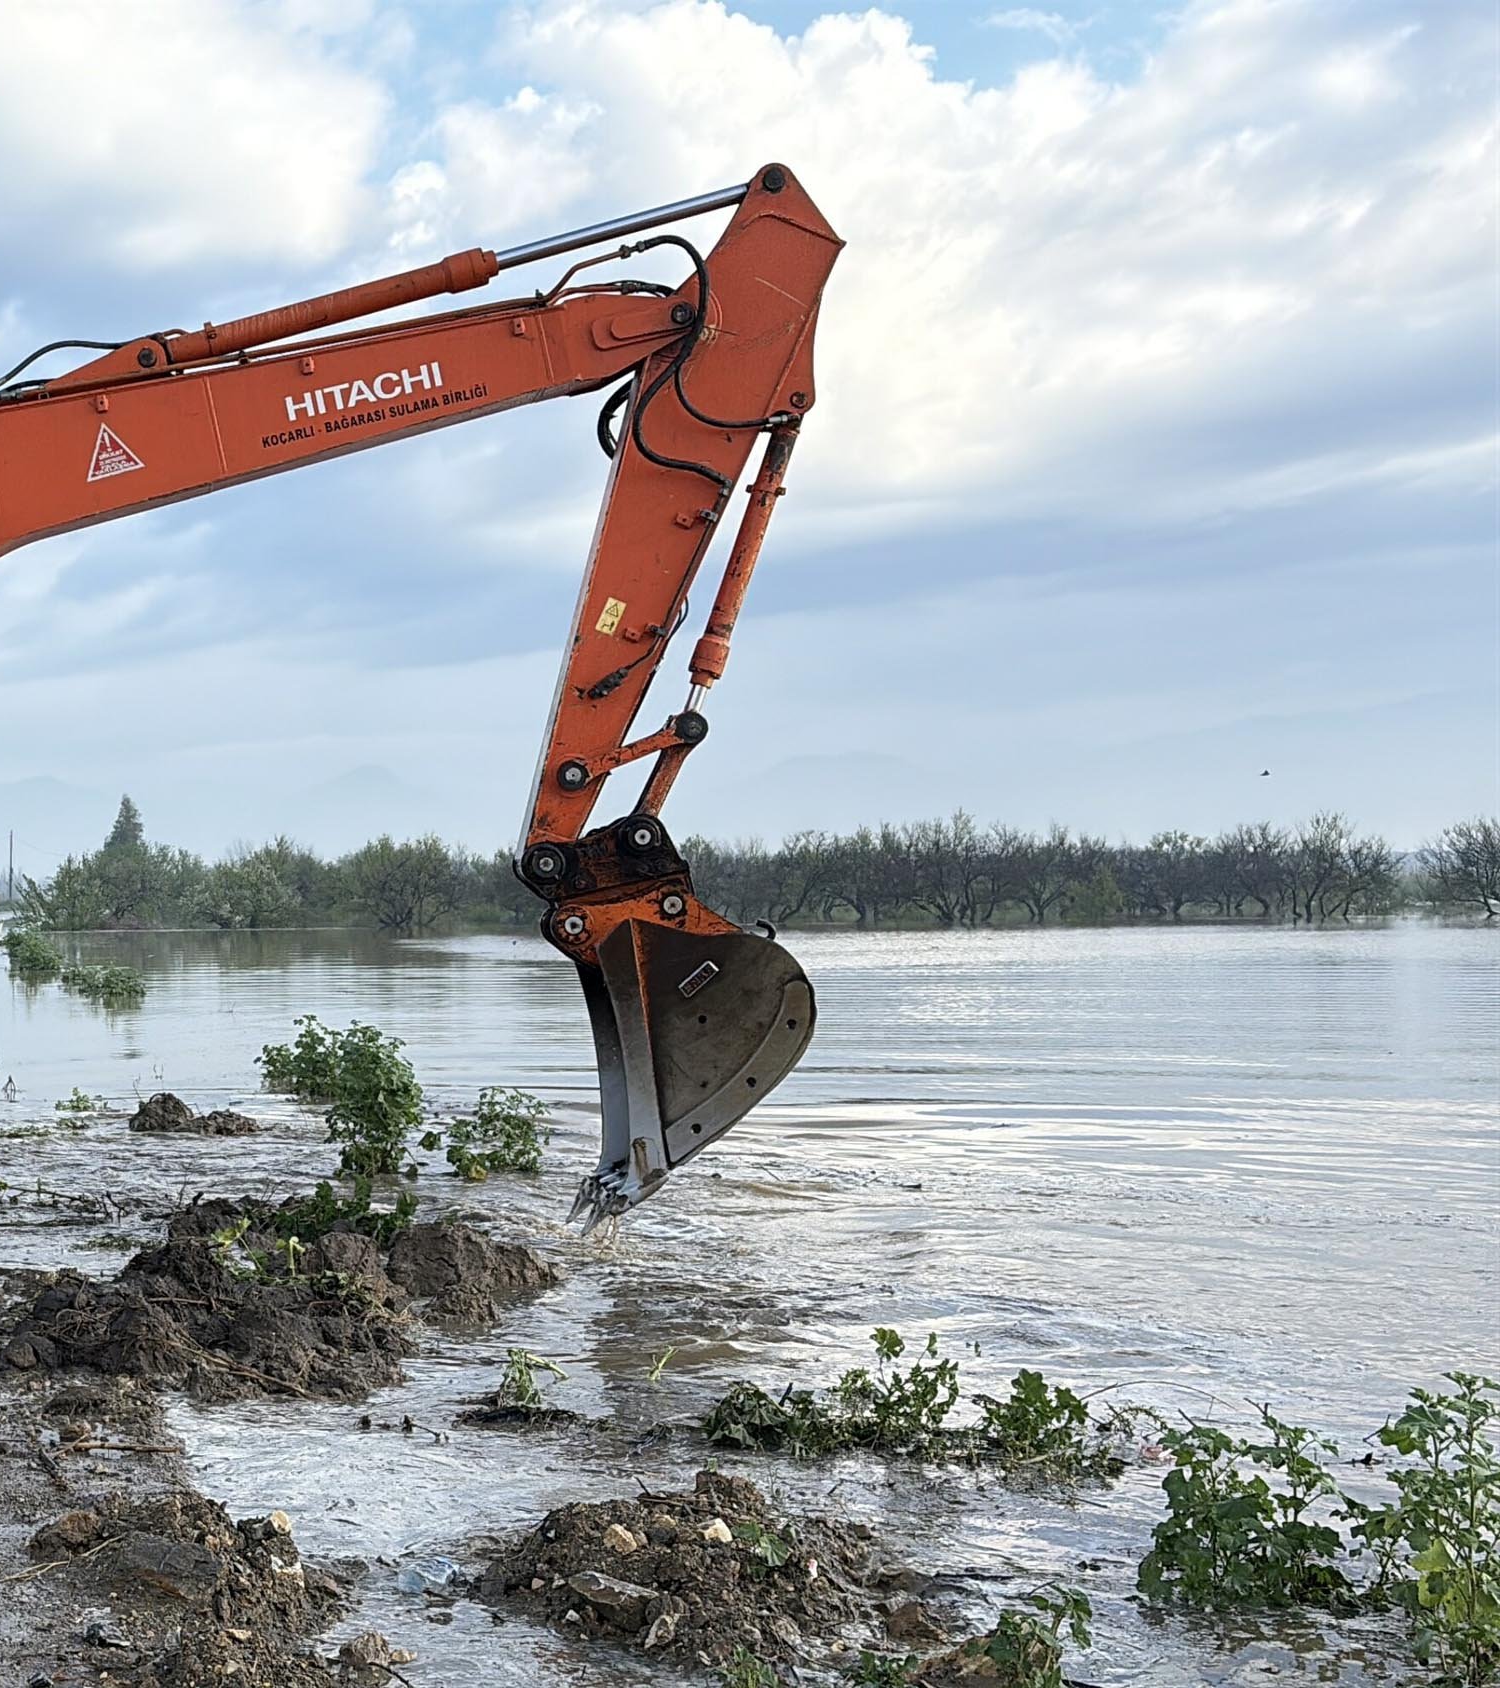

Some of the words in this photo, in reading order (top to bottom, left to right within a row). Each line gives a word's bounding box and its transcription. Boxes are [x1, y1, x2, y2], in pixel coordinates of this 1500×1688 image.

[284, 361, 443, 421] HITACHI
[324, 409, 386, 433] BAĞARASI
[390, 397, 439, 418] SULAMA
